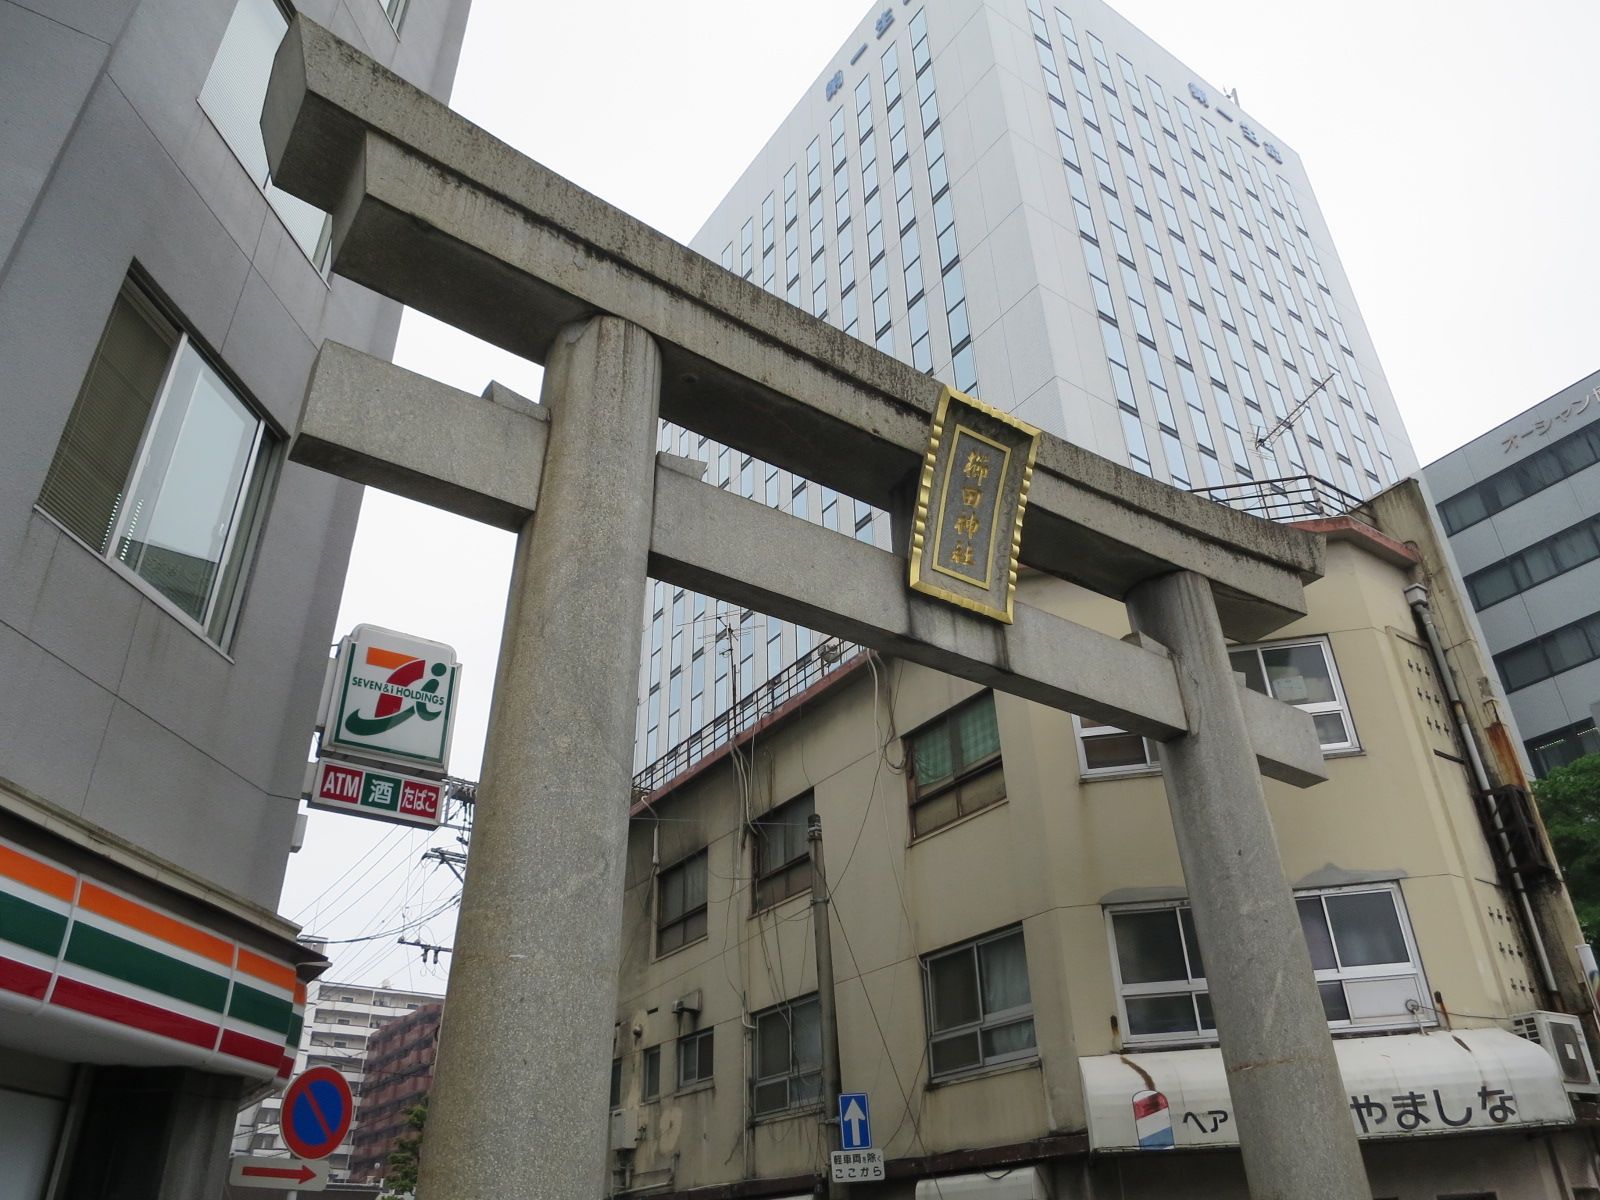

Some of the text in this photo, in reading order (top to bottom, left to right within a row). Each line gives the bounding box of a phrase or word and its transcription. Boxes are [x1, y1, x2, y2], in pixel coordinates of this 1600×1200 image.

[825, 0, 911, 102] 第一生
[395, 686, 445, 706] HOLDINGS
[323, 771, 360, 798] ATM
[368, 778, 395, 805] 酒
[401, 786, 436, 812] たばこ
[1350, 1085, 1520, 1133] やましな
[833, 1152, 882, 1165] 軽車両を除く
[835, 1166, 882, 1179] ここから
